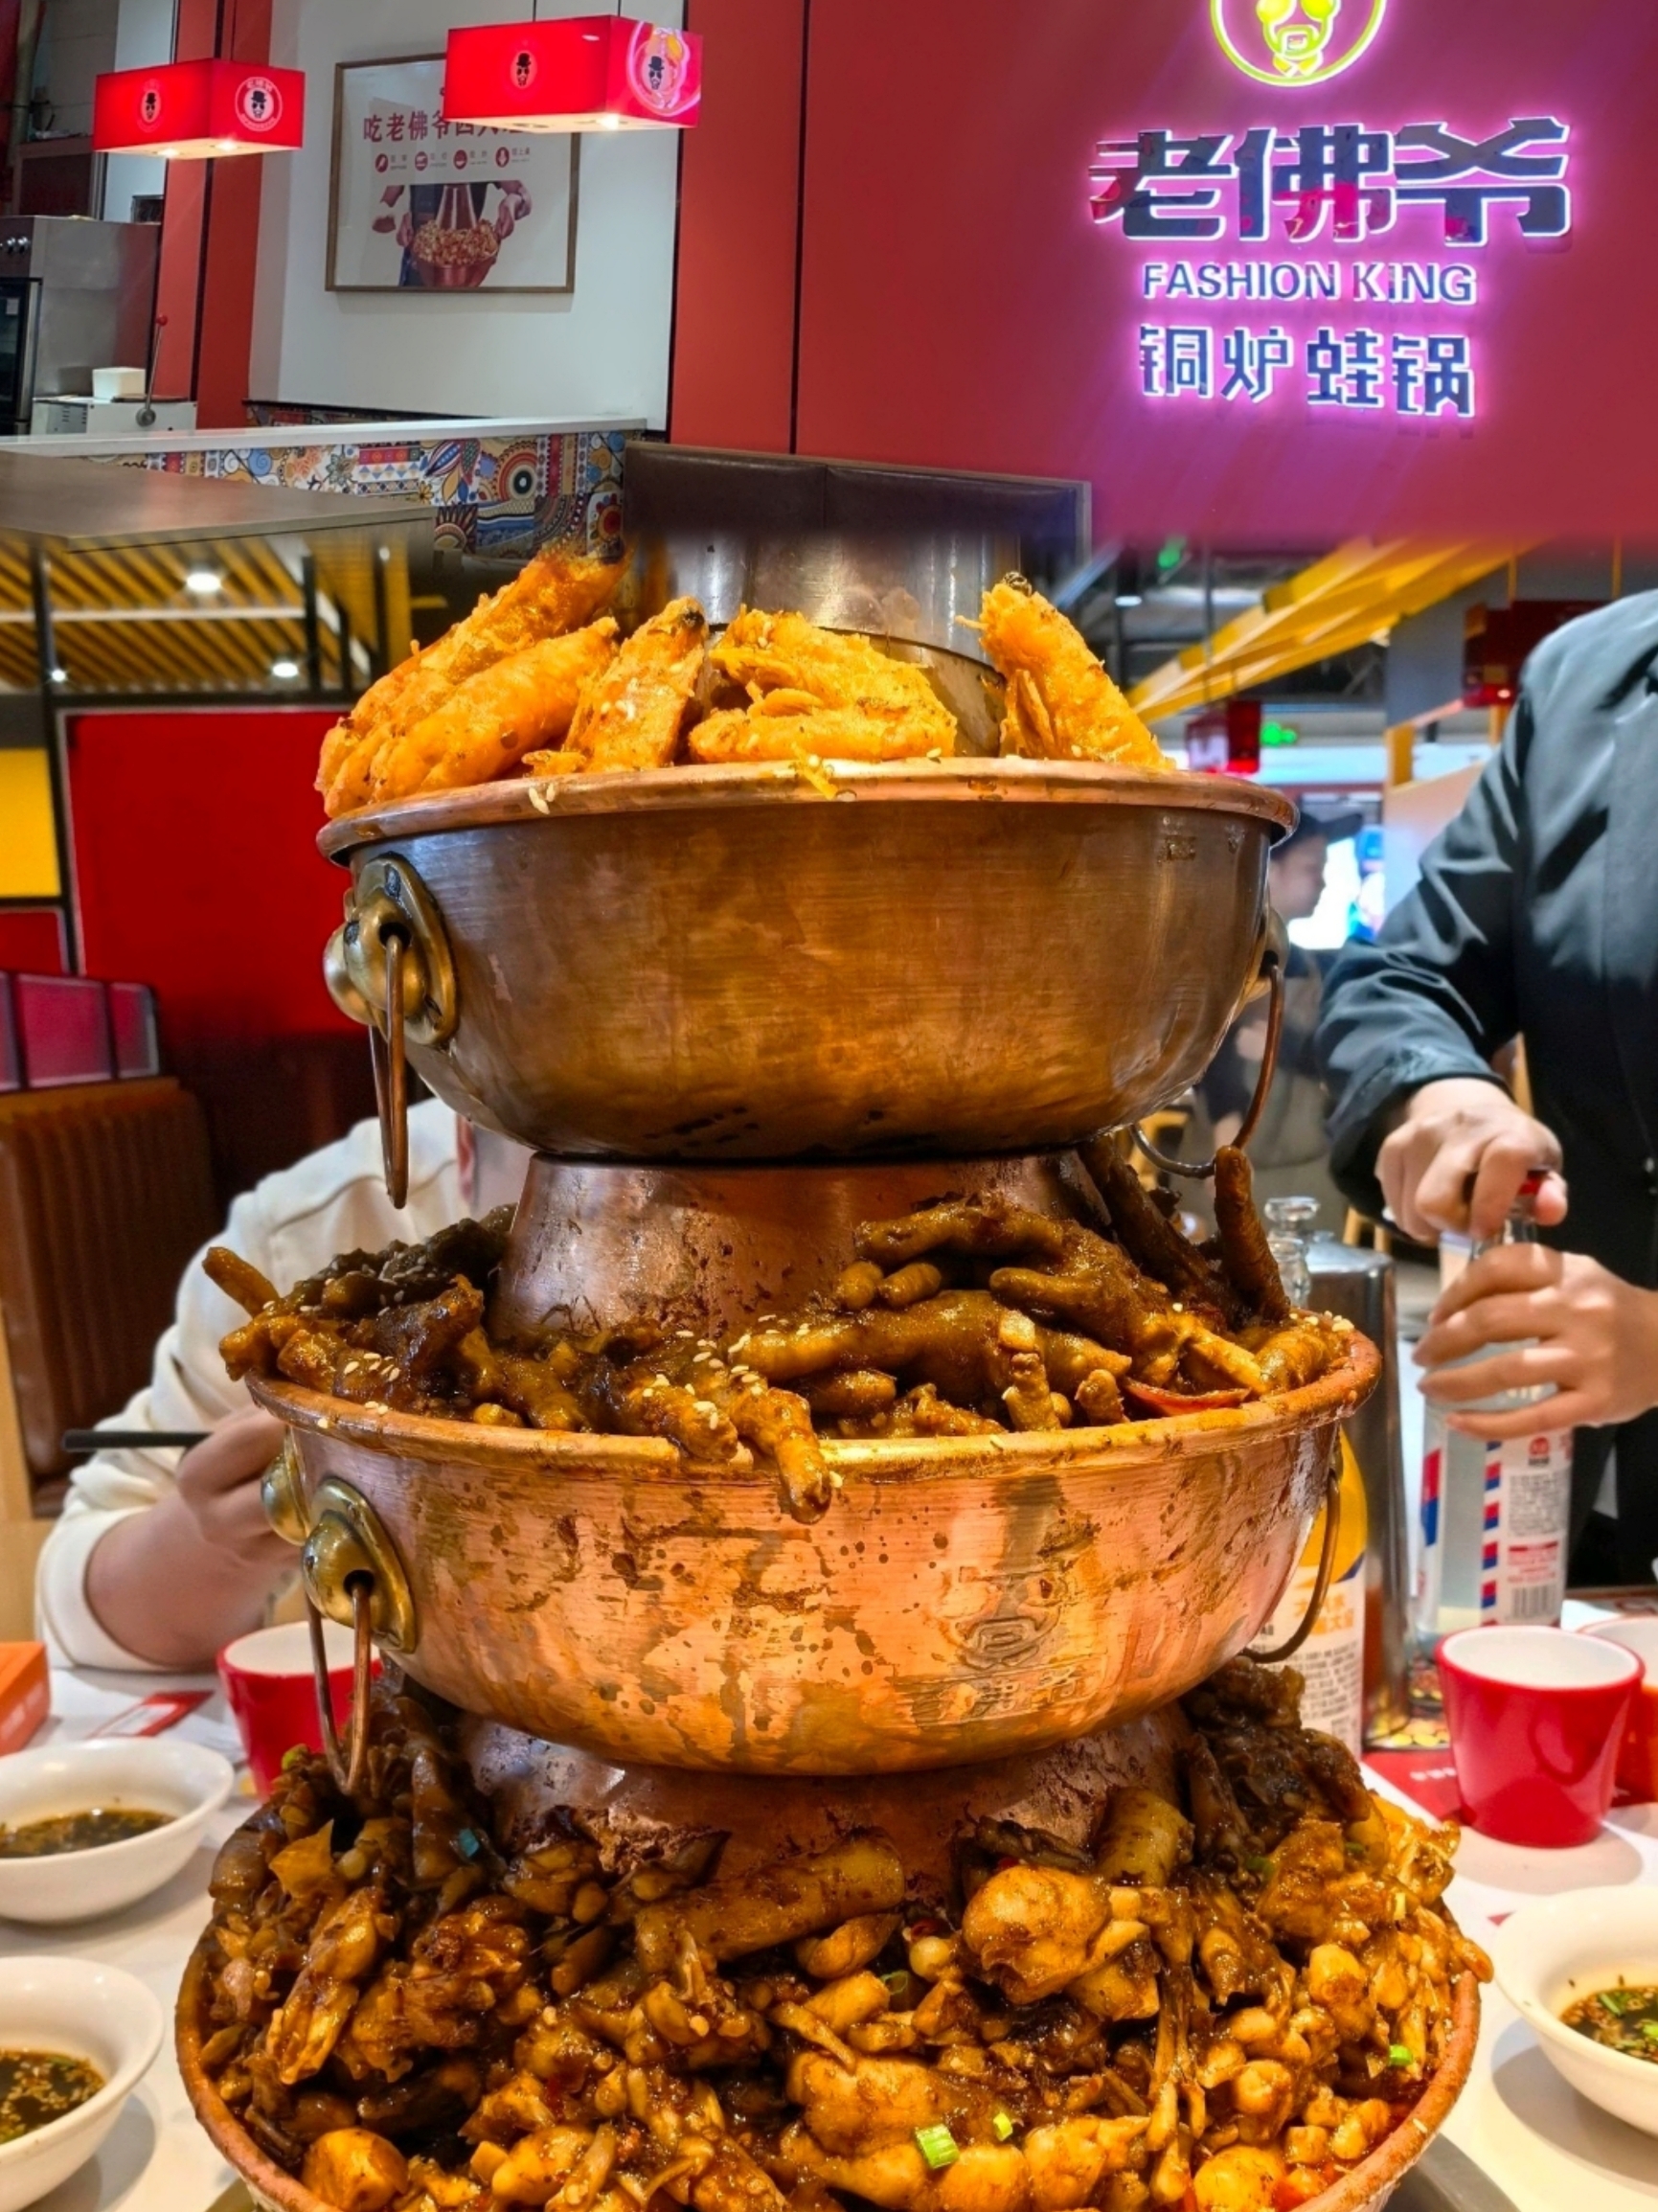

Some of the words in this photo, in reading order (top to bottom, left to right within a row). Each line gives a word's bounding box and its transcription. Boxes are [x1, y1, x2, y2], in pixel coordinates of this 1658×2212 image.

[1088, 116, 1572, 247] 老佛爷
[1142, 261, 1341, 301] FASHION
[1351, 262, 1478, 305] KING
[1139, 324, 1475, 418] 铜炉蛙锅
